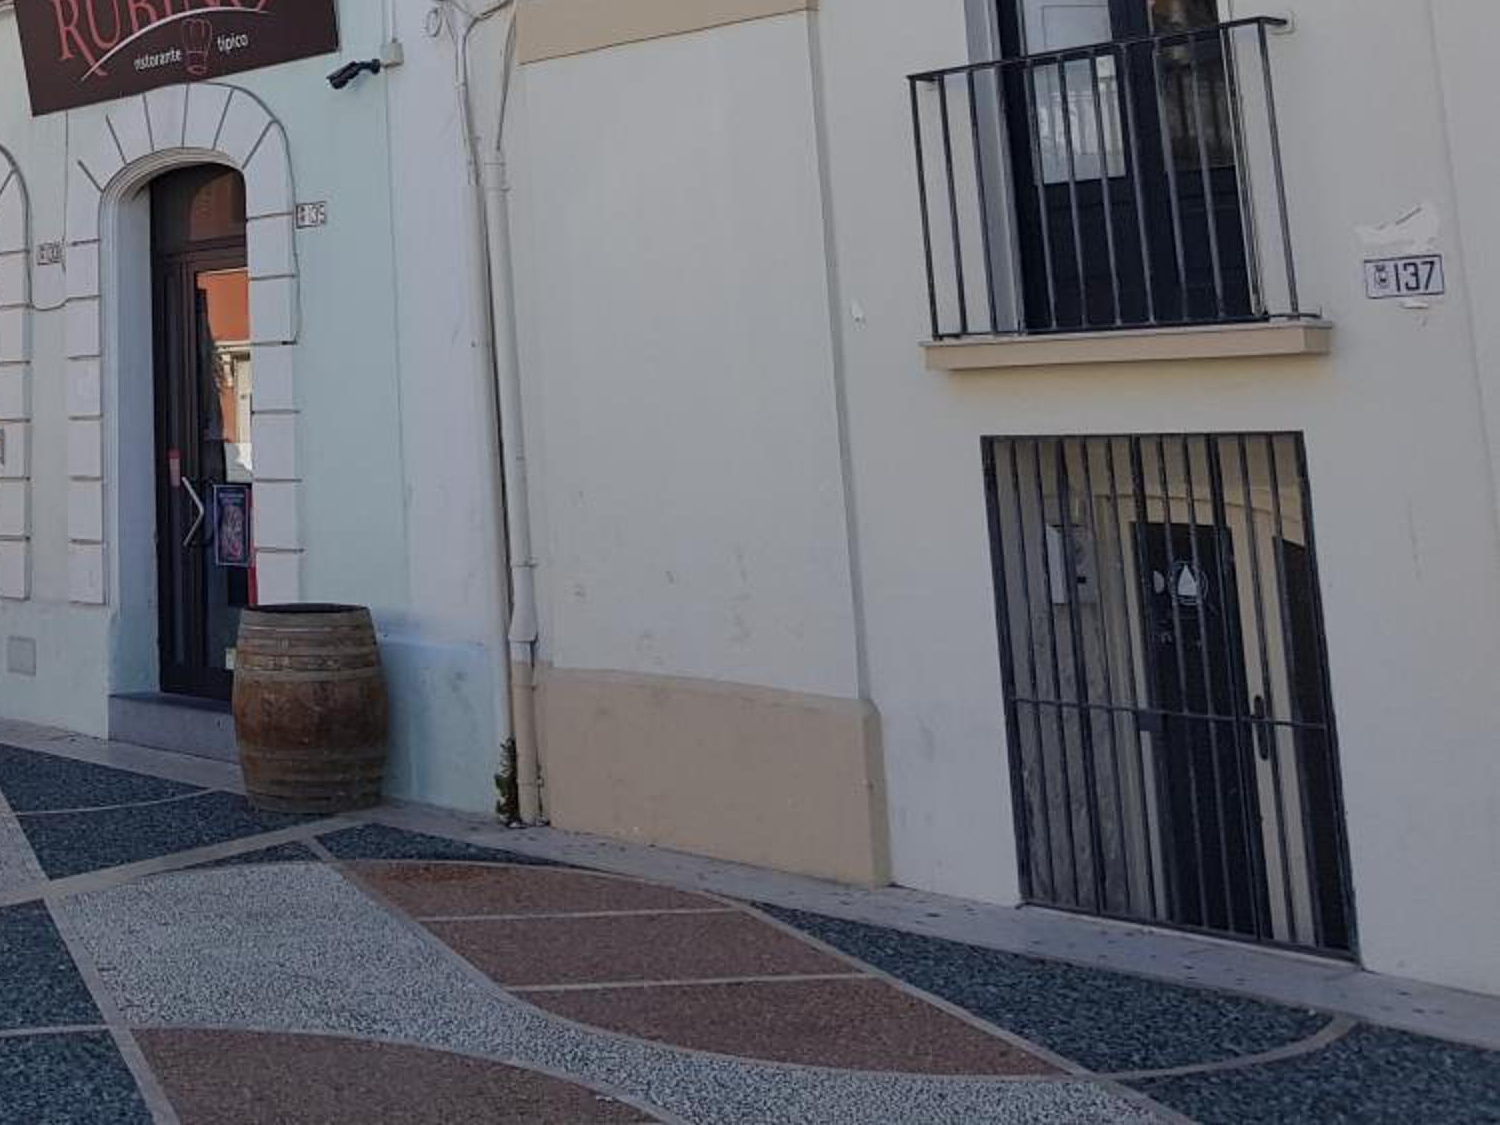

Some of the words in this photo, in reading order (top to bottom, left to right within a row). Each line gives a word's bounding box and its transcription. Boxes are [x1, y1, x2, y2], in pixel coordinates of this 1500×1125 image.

[133, 47, 182, 71] ristorante
[217, 32, 249, 54] tipico
[1393, 260, 1436, 293] 137
